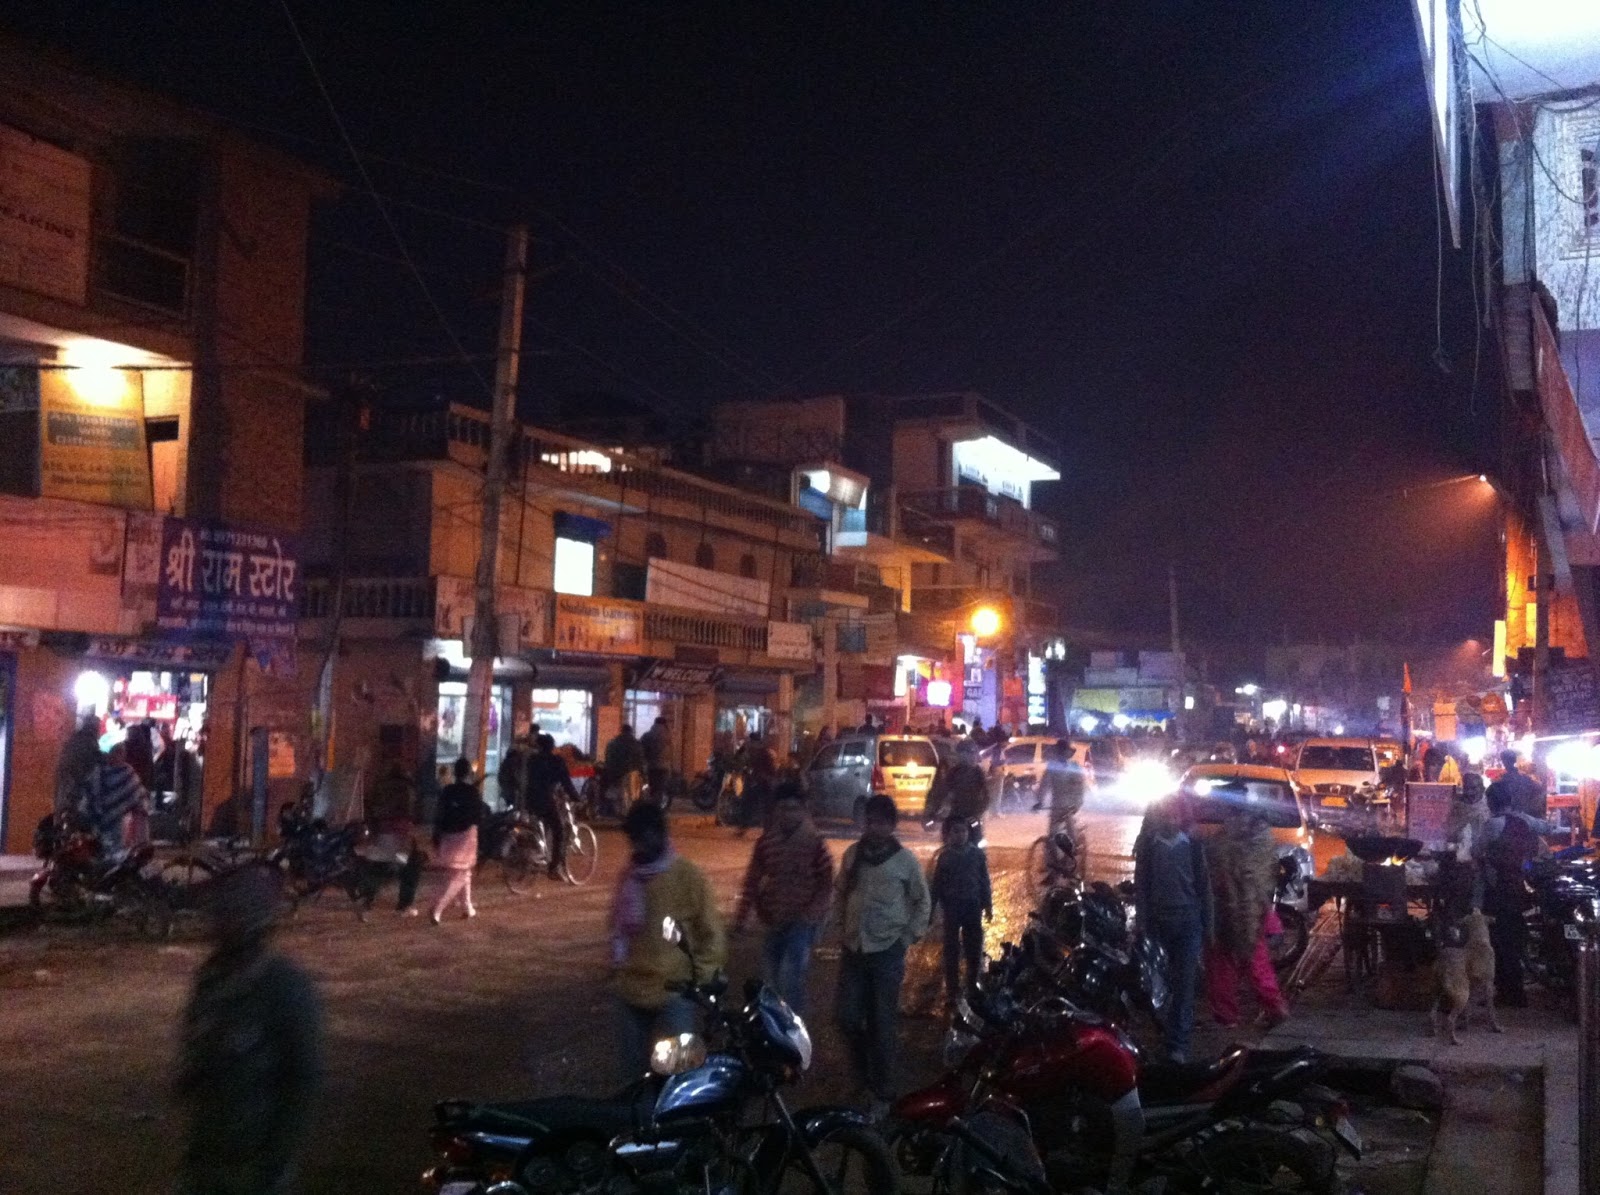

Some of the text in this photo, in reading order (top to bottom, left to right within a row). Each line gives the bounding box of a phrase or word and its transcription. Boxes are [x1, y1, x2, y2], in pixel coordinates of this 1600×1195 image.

[166, 527, 296, 602] श्री राम स्टोर
